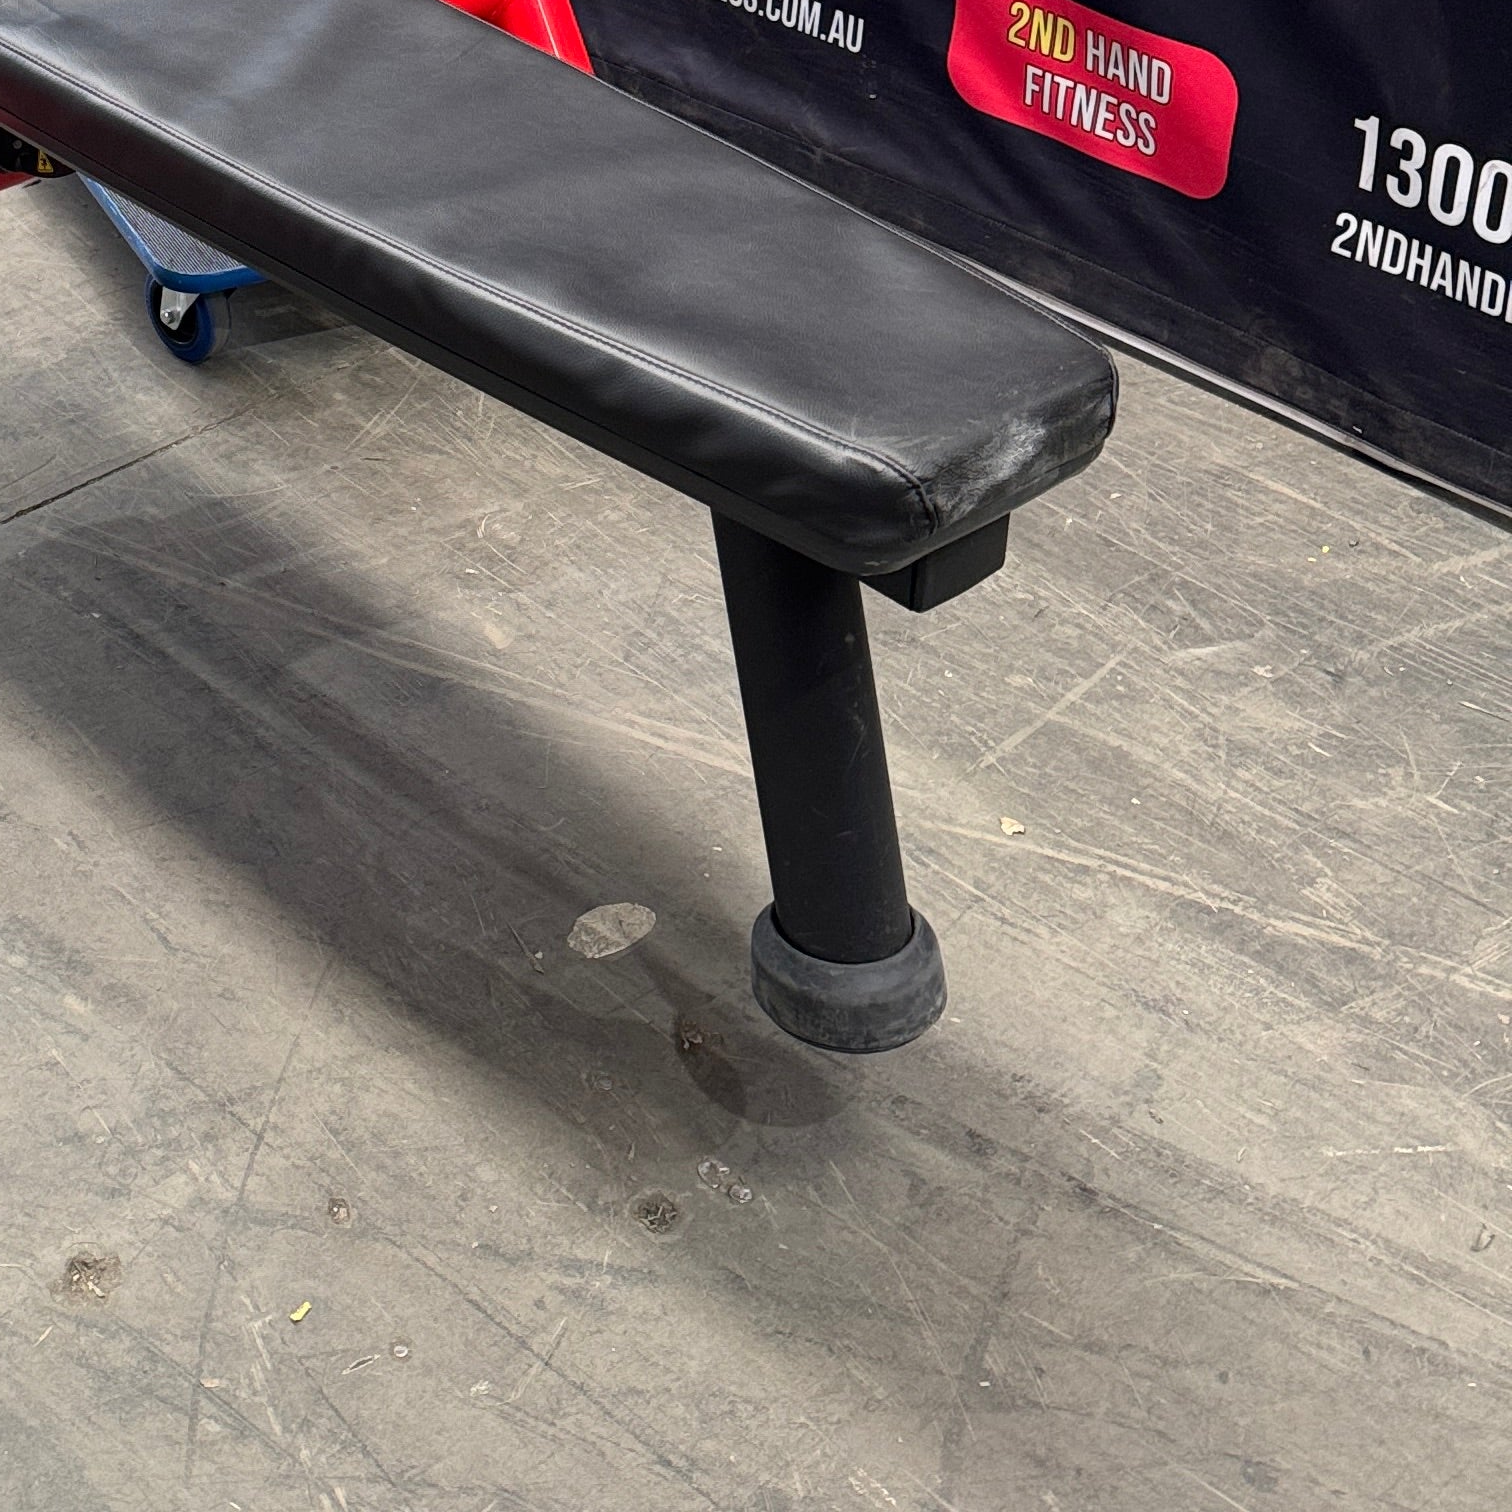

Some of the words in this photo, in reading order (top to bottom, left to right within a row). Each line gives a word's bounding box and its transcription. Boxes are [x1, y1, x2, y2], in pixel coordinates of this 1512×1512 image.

[1008, 1, 1075, 62] 2ND
[1086, 30, 1172, 104] HAND
[1025, 64, 1156, 155] FITNESS
[1354, 115, 1512, 244] 1300
